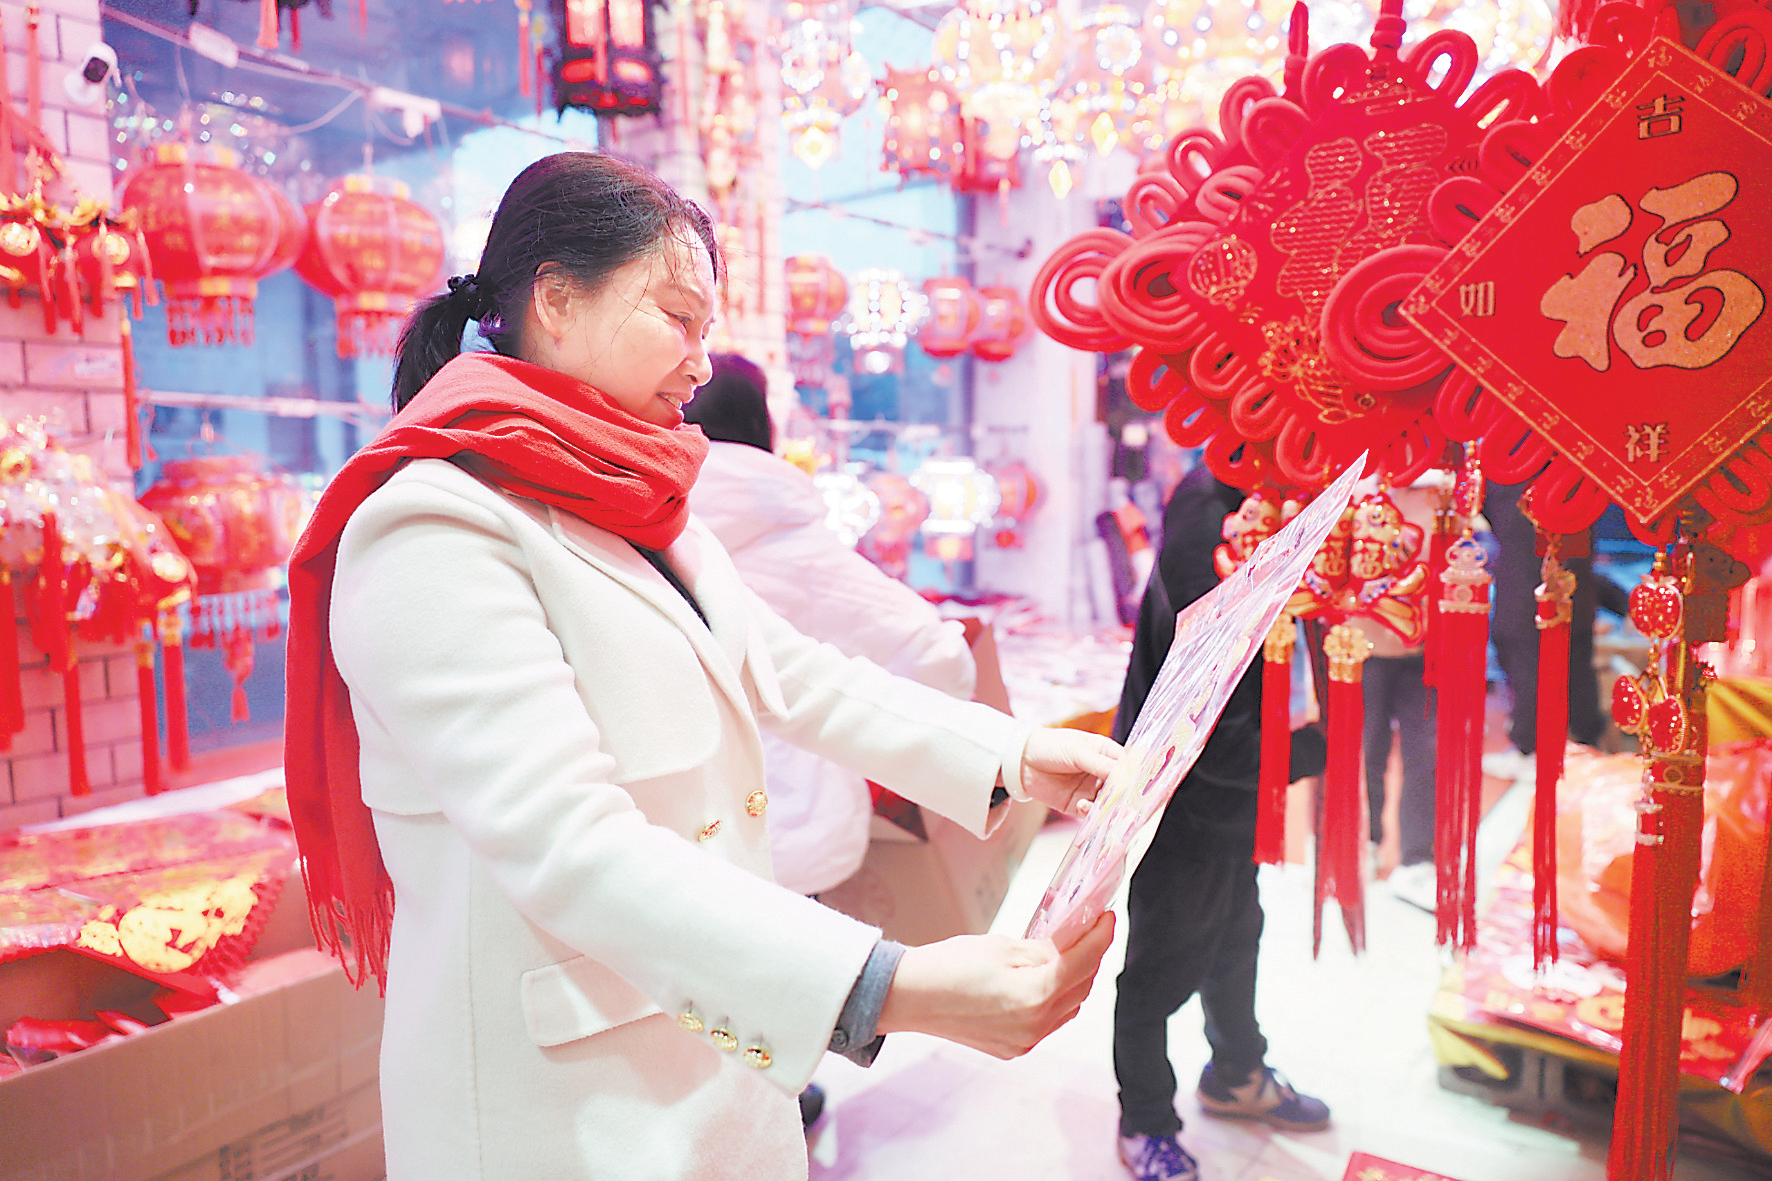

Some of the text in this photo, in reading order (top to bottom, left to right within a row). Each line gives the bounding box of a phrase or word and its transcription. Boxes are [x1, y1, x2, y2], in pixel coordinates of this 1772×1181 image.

[1636, 94, 1684, 140] 吉
[1540, 170, 1767, 374] 福
[1457, 281, 1497, 320] 如
[1623, 422, 1670, 463] 祥
[1351, 539, 1388, 579] 福
